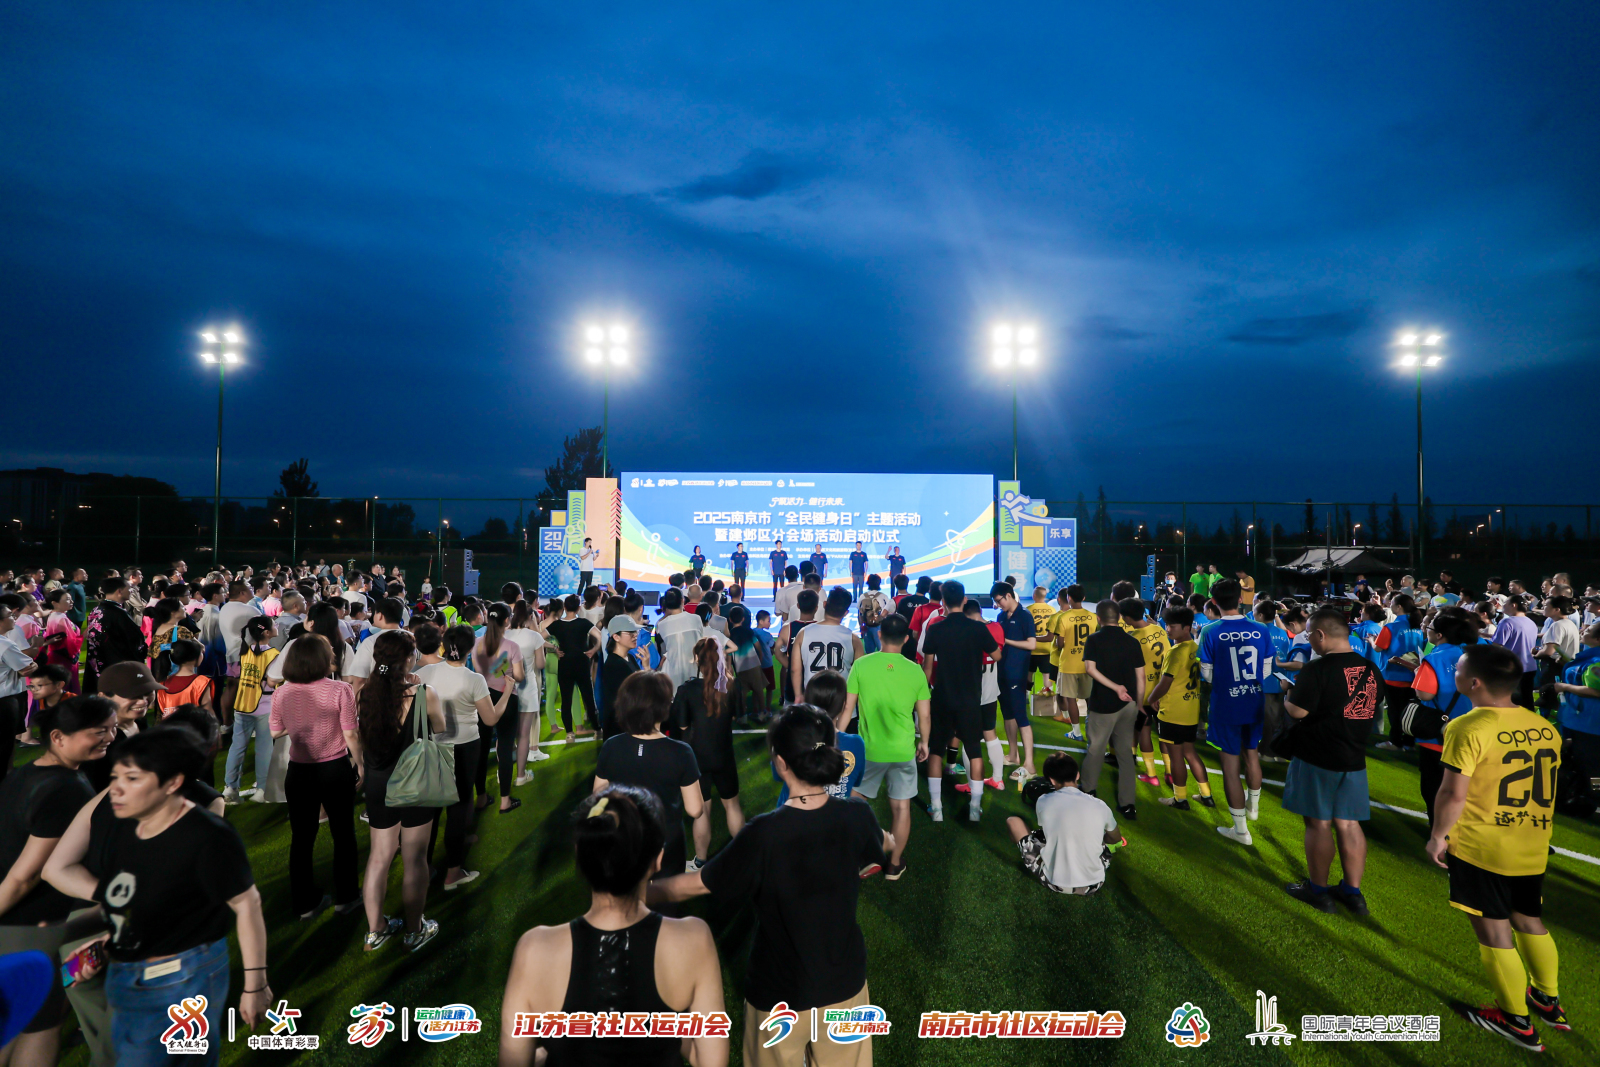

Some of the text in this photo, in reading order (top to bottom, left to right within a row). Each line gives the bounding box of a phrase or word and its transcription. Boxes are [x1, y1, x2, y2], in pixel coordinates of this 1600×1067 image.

[714, 528, 900, 543] 暨建邺区分会场活动启动仪式
[1050, 528, 1072, 539] 乐享
[808, 641, 845, 673] 20
[1229, 645, 1258, 682] 13
[1497, 748, 1557, 808] 20
[1494, 811, 1552, 830] 逐梦计
